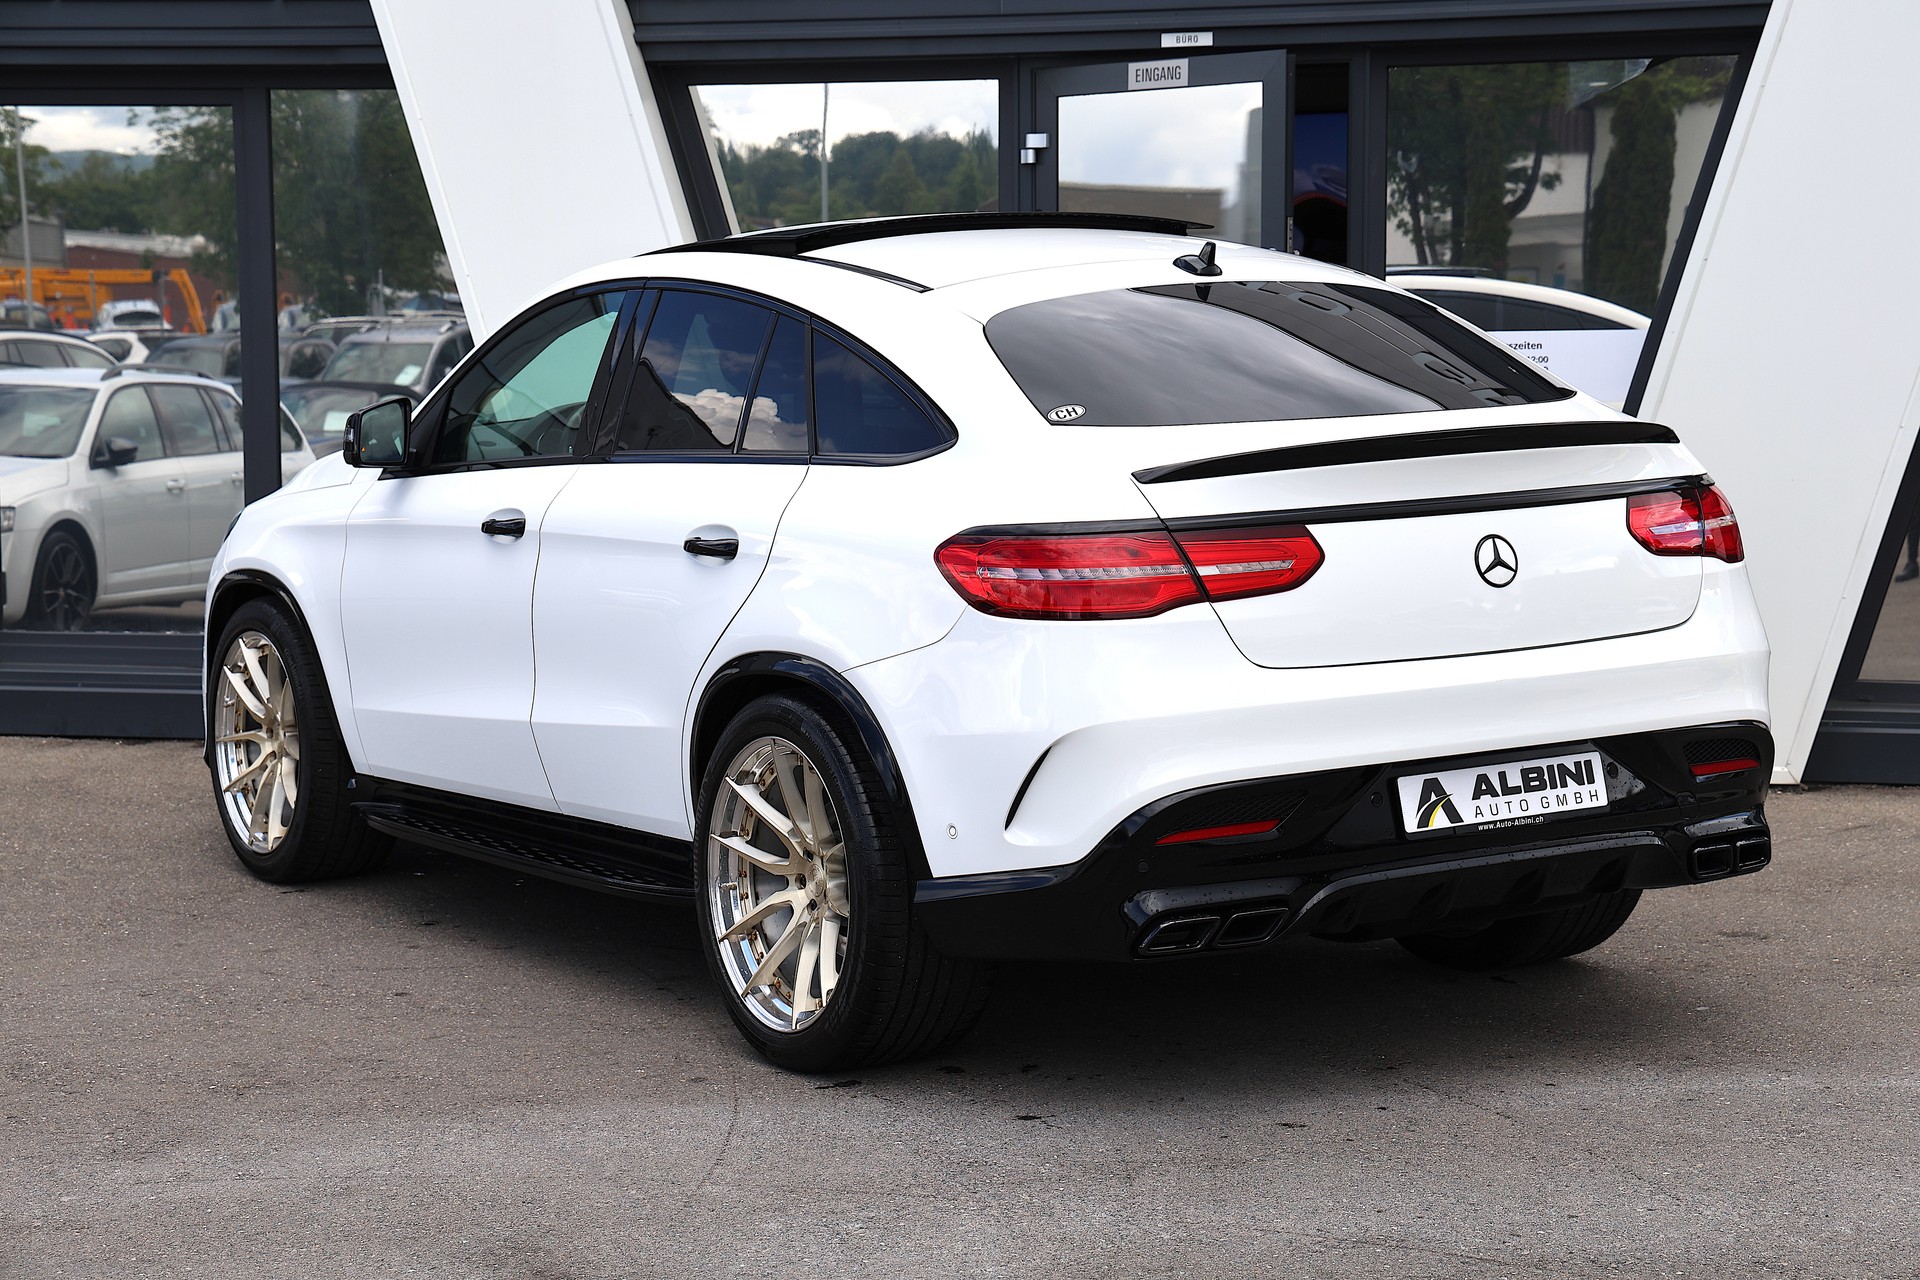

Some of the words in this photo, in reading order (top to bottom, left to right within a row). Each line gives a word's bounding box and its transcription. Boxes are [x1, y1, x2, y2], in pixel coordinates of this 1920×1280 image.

[1175, 34, 1199, 44] BÜRO
[1135, 65, 1182, 84] EINGANG
[1506, 341, 1543, 350] szeiten
[1055, 407, 1078, 420] CH
[1471, 759, 1596, 801] ALBINI
[1474, 798, 1530, 819] AUTO
[1540, 789, 1600, 809] GMBH
[1477, 815, 1544, 831] www.Auto-Albini.ch
